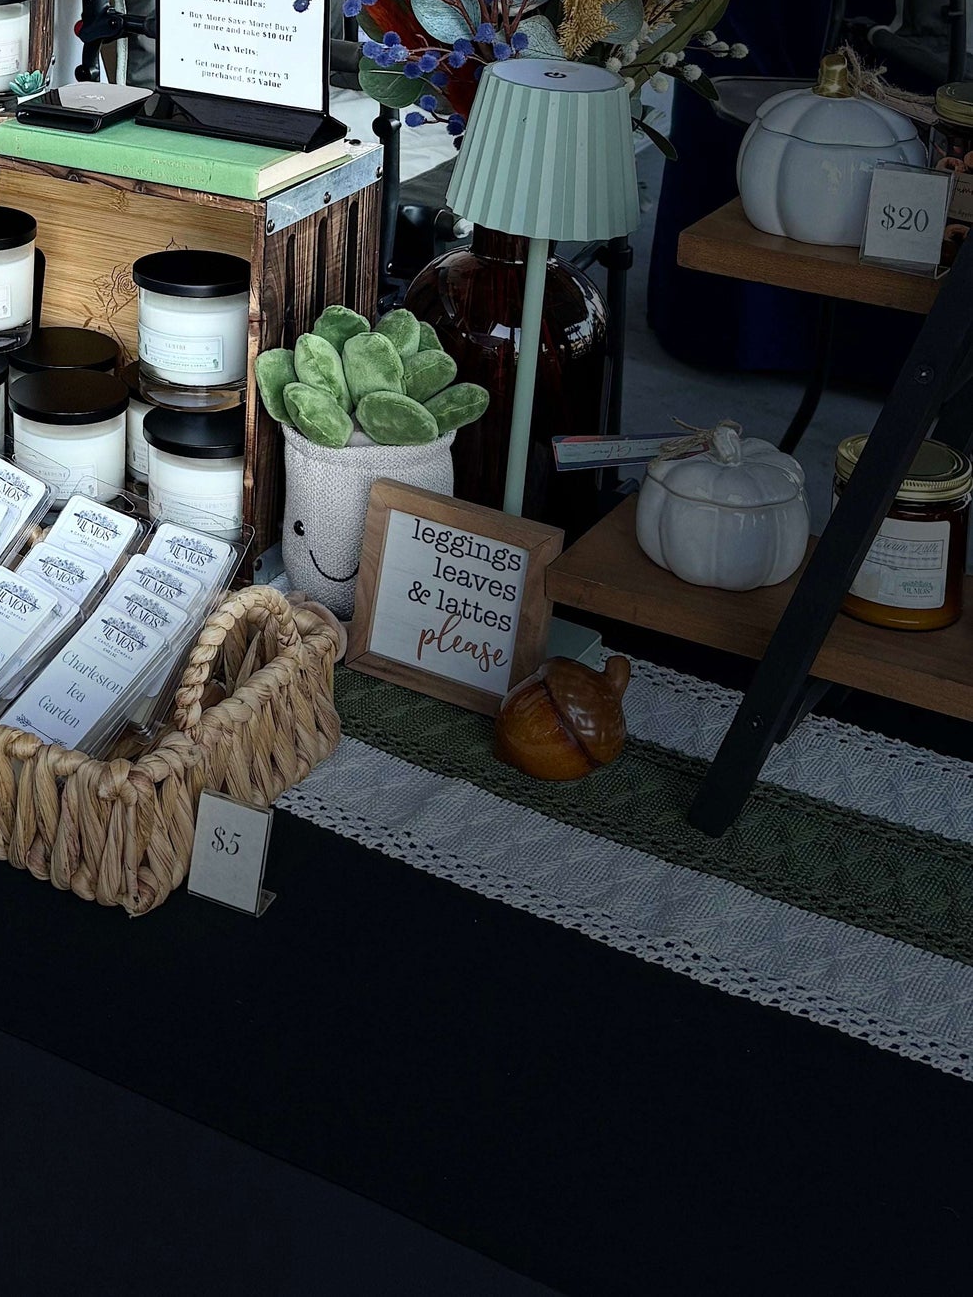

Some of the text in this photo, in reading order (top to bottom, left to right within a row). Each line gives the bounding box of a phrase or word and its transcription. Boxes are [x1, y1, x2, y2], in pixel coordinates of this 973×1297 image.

[189, 11, 203, 19] Buy
[207, 14, 226, 22] More
[228, 17, 246, 25] Save
[275, 22, 290, 32] Buy
[204, 24, 224, 32] more
[243, 28, 260, 37] take
[279, 34, 293, 42] Off
[214, 43, 230, 52] Wax
[195, 59, 208, 67] Get
[227, 64, 242, 72] free
[245, 67, 257, 75] for
[259, 70, 281, 79] every
[258, 78, 282, 88] Value
[881, 203, 929, 232] $20
[79, 518, 112, 542] LUMOS
[411, 518, 522, 572] leggings
[432, 557, 517, 602] leaves
[407, 580, 512, 632] & lattes
[104, 625, 137, 653] LUMOS
[417, 612, 508, 673] please
[62, 649, 123, 695] Charleston
[66, 681, 86, 703] Tea
[38, 695, 80, 728] Garden
[211, 826, 242, 856] $5
